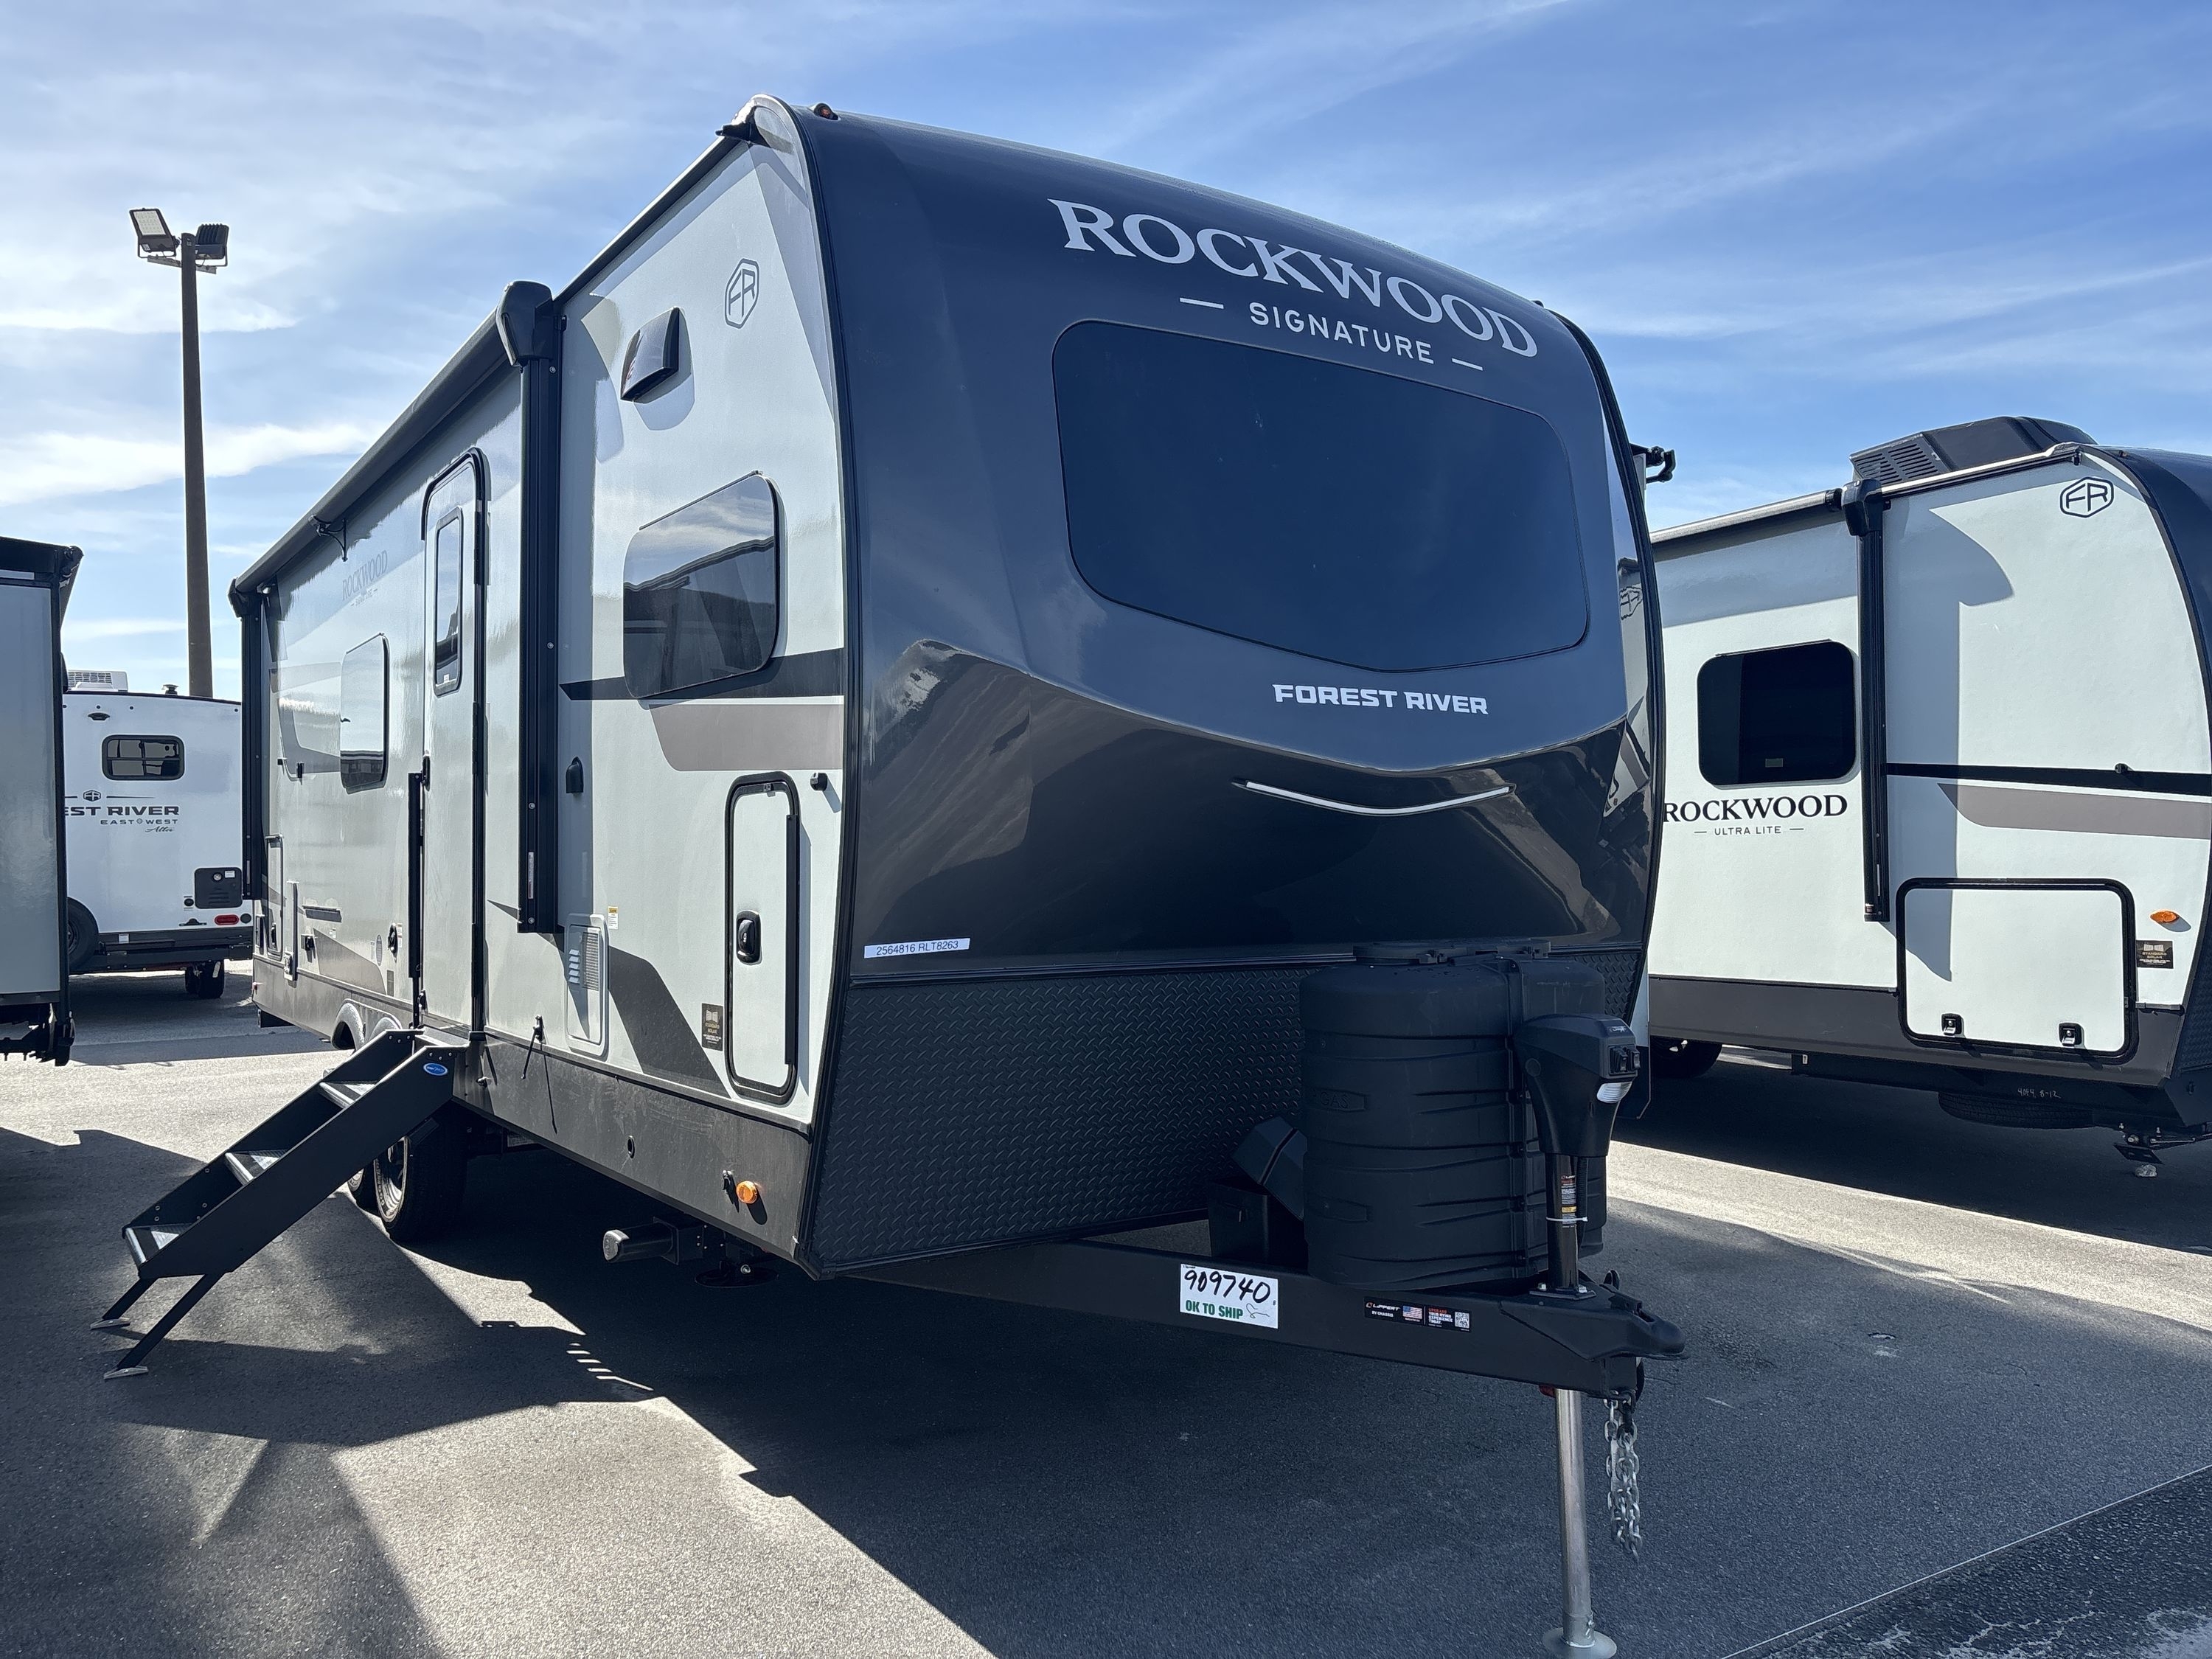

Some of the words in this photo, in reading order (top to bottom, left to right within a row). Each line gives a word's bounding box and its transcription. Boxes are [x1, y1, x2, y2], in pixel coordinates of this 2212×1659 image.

[1047, 198, 1538, 358] ROCKWOOD
[1248, 302, 1434, 364] SIGNATURE
[342, 549, 388, 602] ROCKWOOD
[1272, 684, 1397, 708] FOREST
[1403, 691, 1489, 714] RIVER
[106, 806, 179, 815] RIVER
[1663, 794, 1848, 823] ROCKWOOD
[1714, 827, 1751, 836] ULTRA
[1756, 826, 1782, 835] LITE
[876, 943, 916, 956] 2564816
[918, 940, 959, 952] RLT8263
[1184, 1270, 1270, 1304] 909740
[1186, 1300, 1200, 1313] OK
[1203, 1302, 1216, 1315] TO
[1218, 1305, 1244, 1320] SHIP
